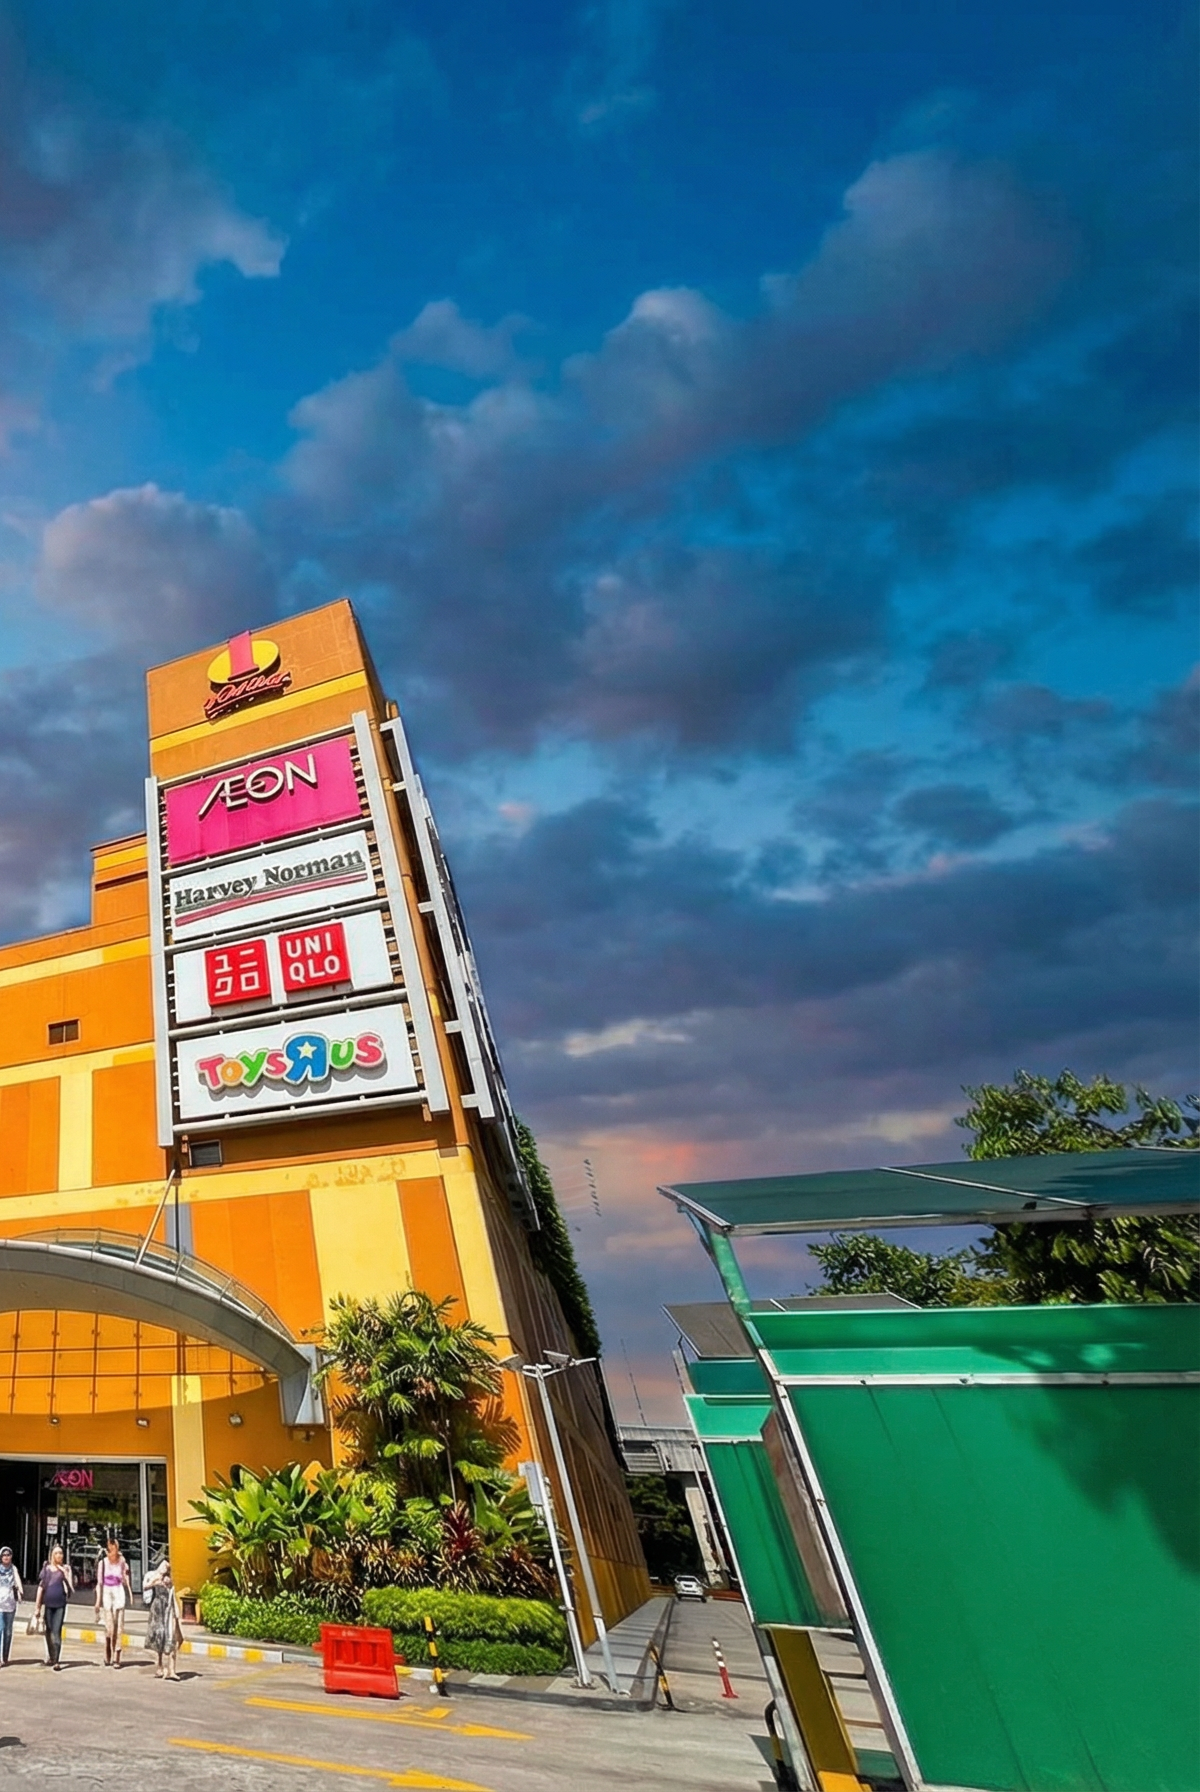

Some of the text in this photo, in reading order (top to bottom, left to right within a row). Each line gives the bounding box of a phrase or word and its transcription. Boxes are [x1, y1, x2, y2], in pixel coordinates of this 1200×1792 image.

[174, 850, 364, 908] Harvey Norman
[285, 931, 332, 958] UNI
[288, 955, 340, 984] QLO
